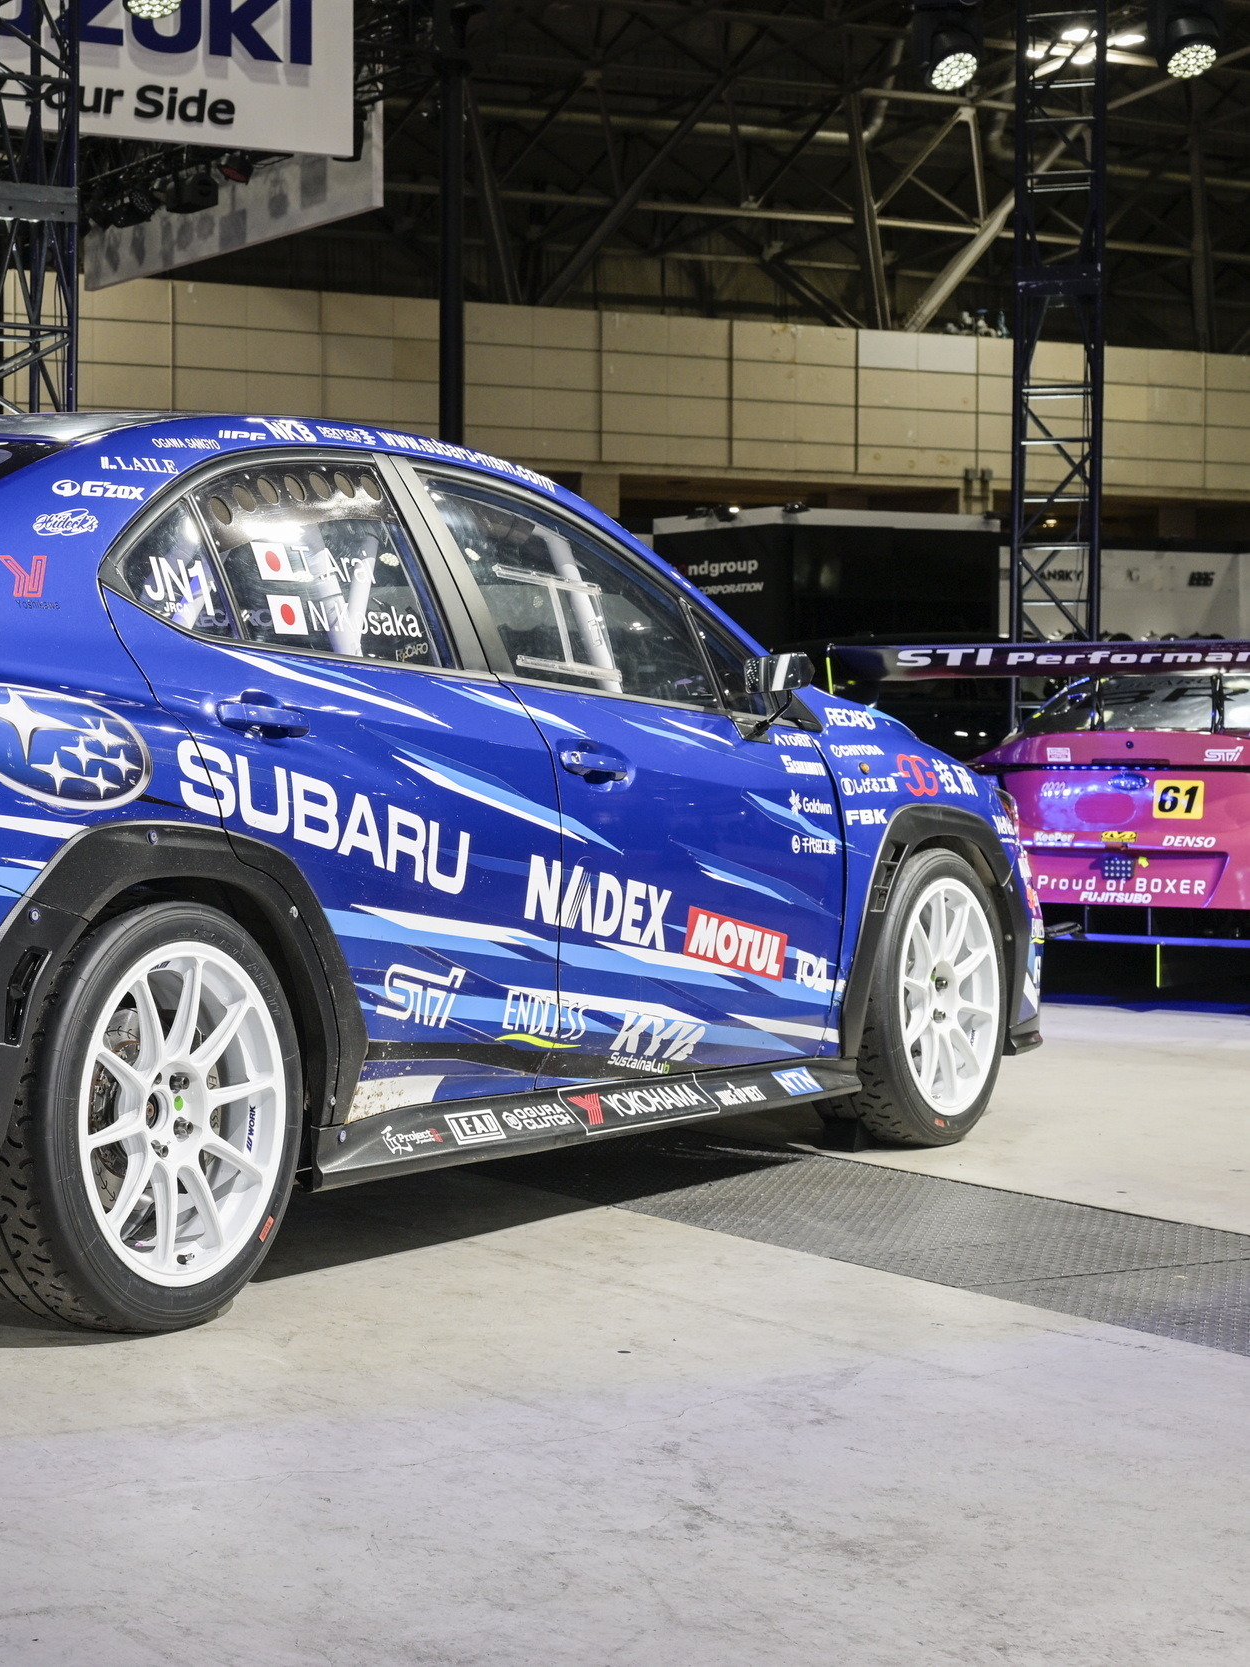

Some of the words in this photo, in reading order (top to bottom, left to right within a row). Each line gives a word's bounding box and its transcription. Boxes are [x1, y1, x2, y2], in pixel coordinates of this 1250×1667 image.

[134, 84, 236, 125] Side
[152, 437, 186, 449] OGAWA
[186, 438, 221, 450] SANGYO
[264, 420, 318, 444] NKB
[679, 559, 759, 577] ondgroup
[144, 556, 216, 617] JN1
[15, 599, 61, 610] Yoshikawa
[307, 600, 422, 638] N.Kosaka
[896, 648, 993, 666] STI
[824, 707, 877, 731] RECARO
[841, 744, 885, 756] CHIYODA
[802, 796, 833, 815] Goldwin
[1157, 785, 1199, 814] 61
[177, 740, 470, 895] SUBARU
[845, 808, 888, 826] FBK
[1034, 831, 1075, 844] KeePer
[1162, 835, 1217, 848] DENSO
[1037, 875, 1096, 891] Proud
[1106, 877, 1126, 892] of
[1135, 877, 1207, 895] BOXER
[1079, 890, 1152, 904] FUJITSUBO
[524, 854, 672, 951] NADEX
[688, 913, 781, 976] MOTUL
[502, 990, 590, 1041] ENDLESS
[609, 1009, 706, 1062] KYB
[777, 1069, 820, 1095] NTN
[513, 1102, 567, 1118] OGURA
[599, 1083, 707, 1117] YOKOHAMA
[248, 1104, 257, 1136] WORK
[451, 1113, 500, 1138] LEAD
[525, 1111, 575, 1130] CLUTCH
